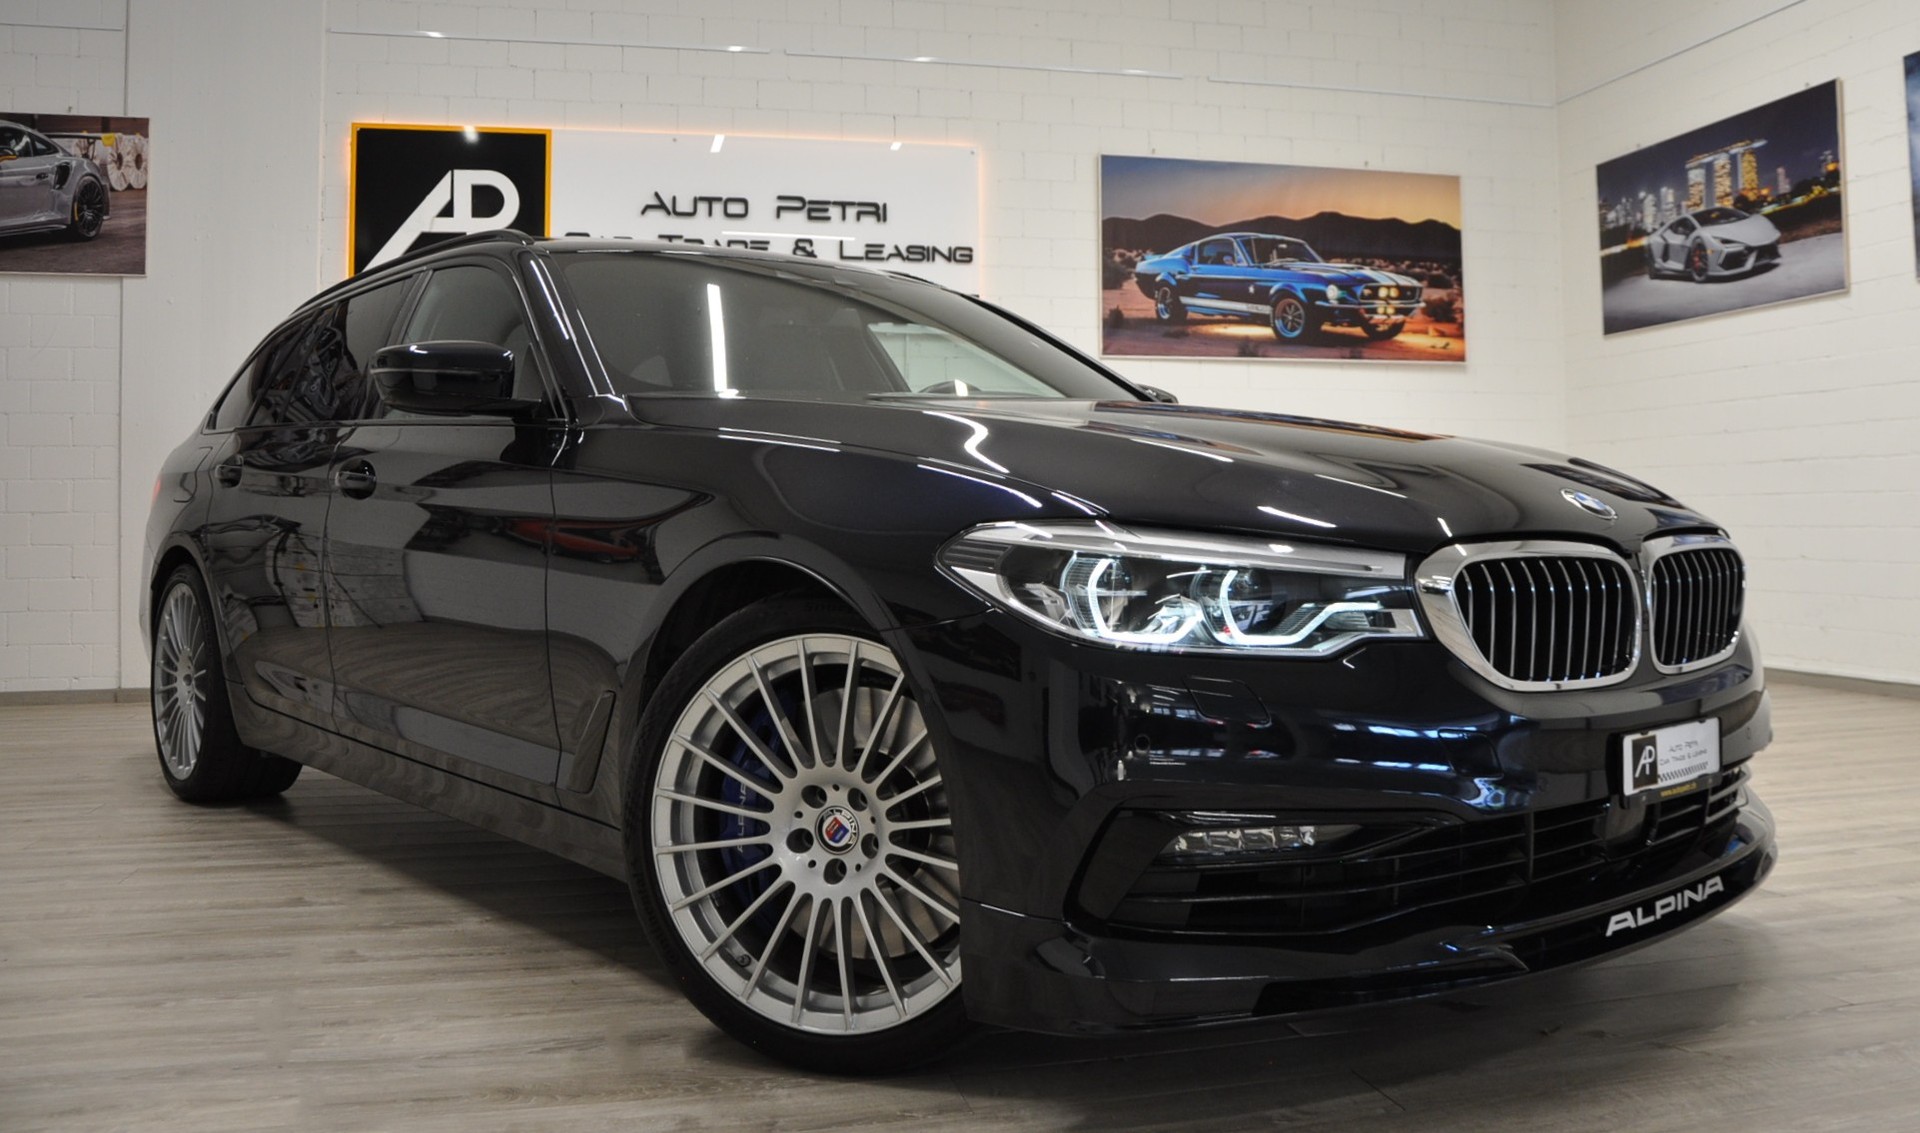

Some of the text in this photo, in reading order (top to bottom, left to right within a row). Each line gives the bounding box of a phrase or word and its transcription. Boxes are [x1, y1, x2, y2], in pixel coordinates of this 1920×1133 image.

[640, 191, 888, 223] AUTO PETRI
[792, 238, 818, 259] &
[838, 239, 975, 264] LEASING
[1605, 875, 1725, 937] ALPINA
